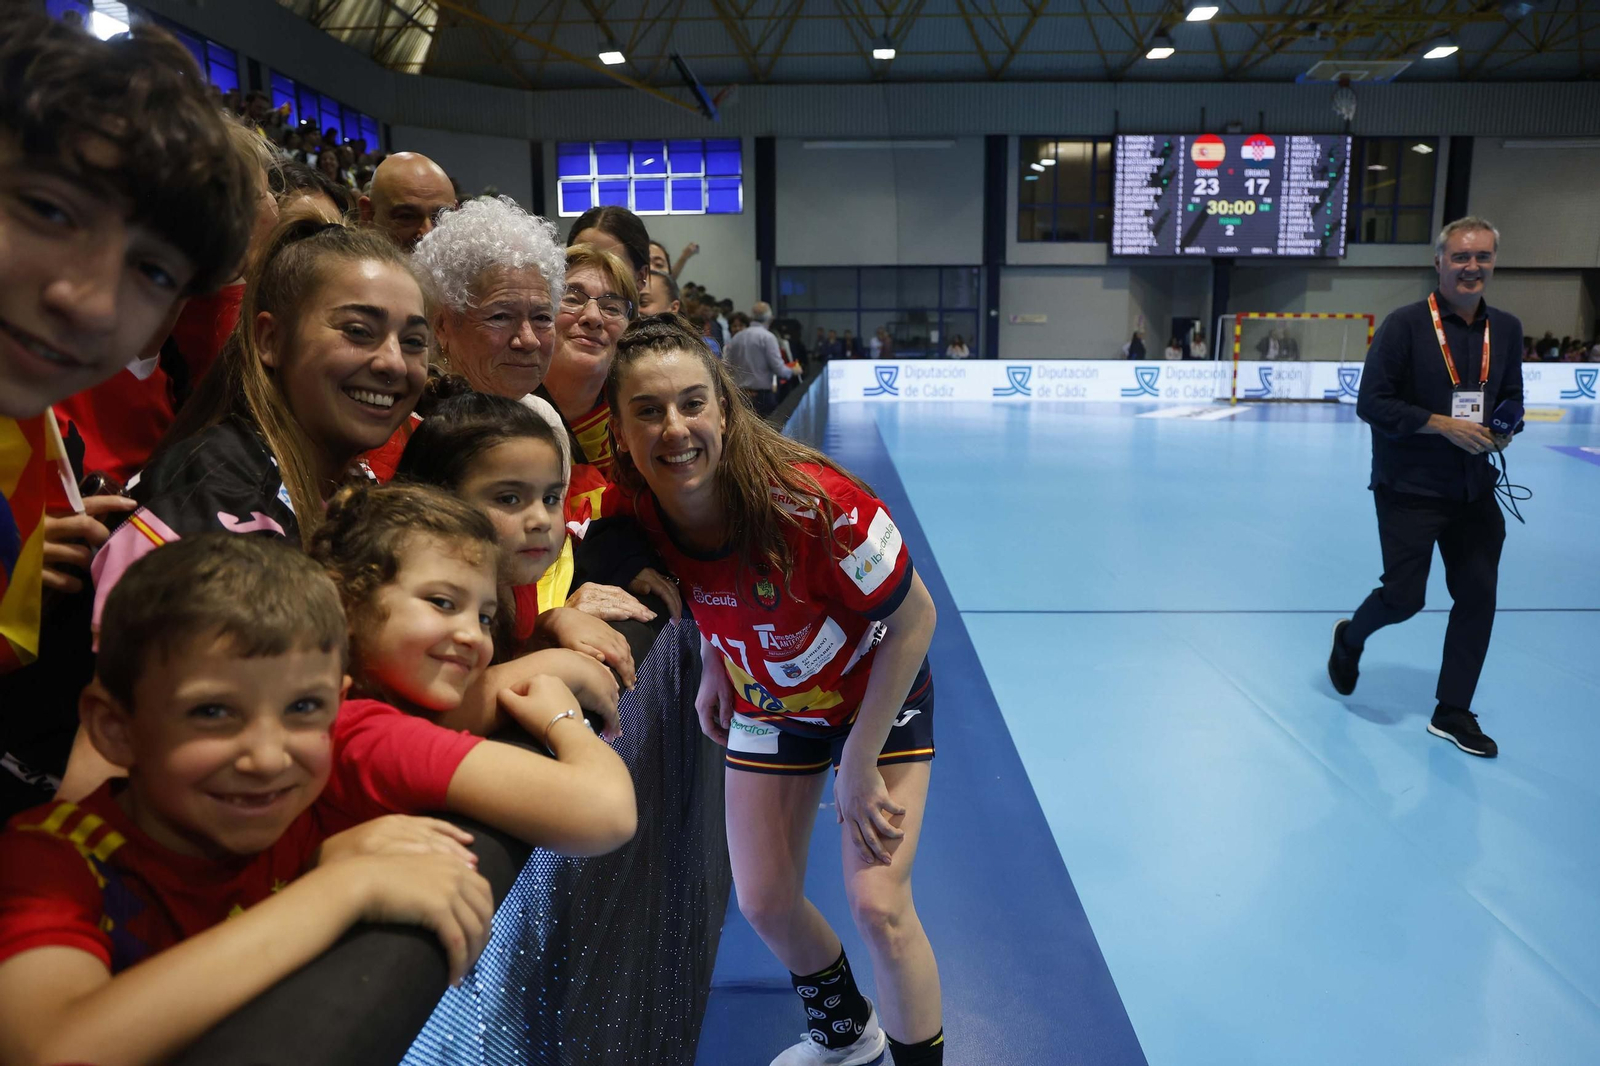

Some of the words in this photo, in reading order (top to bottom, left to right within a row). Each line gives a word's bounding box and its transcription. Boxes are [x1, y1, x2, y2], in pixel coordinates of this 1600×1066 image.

[1193, 178, 1220, 195] 23
[1244, 178, 1270, 195] 17
[1206, 200, 1256, 215] 30:00
[1225, 225, 1234, 236] 2
[905, 366, 966, 380] Diputación
[1038, 366, 1098, 380] Diputación
[905, 384, 920, 397] de
[923, 384, 954, 397] Cádiz
[1038, 385, 1052, 397] de
[1056, 385, 1086, 397] Cádiz
[1166, 385, 1180, 398] de
[1184, 385, 1215, 398] Cádiz
[870, 523, 895, 565] Iberdrola
[705, 594, 738, 607] Ceuta
[802, 638, 828, 664] GOBIERNO
[806, 642, 834, 669] CANTABRIA
